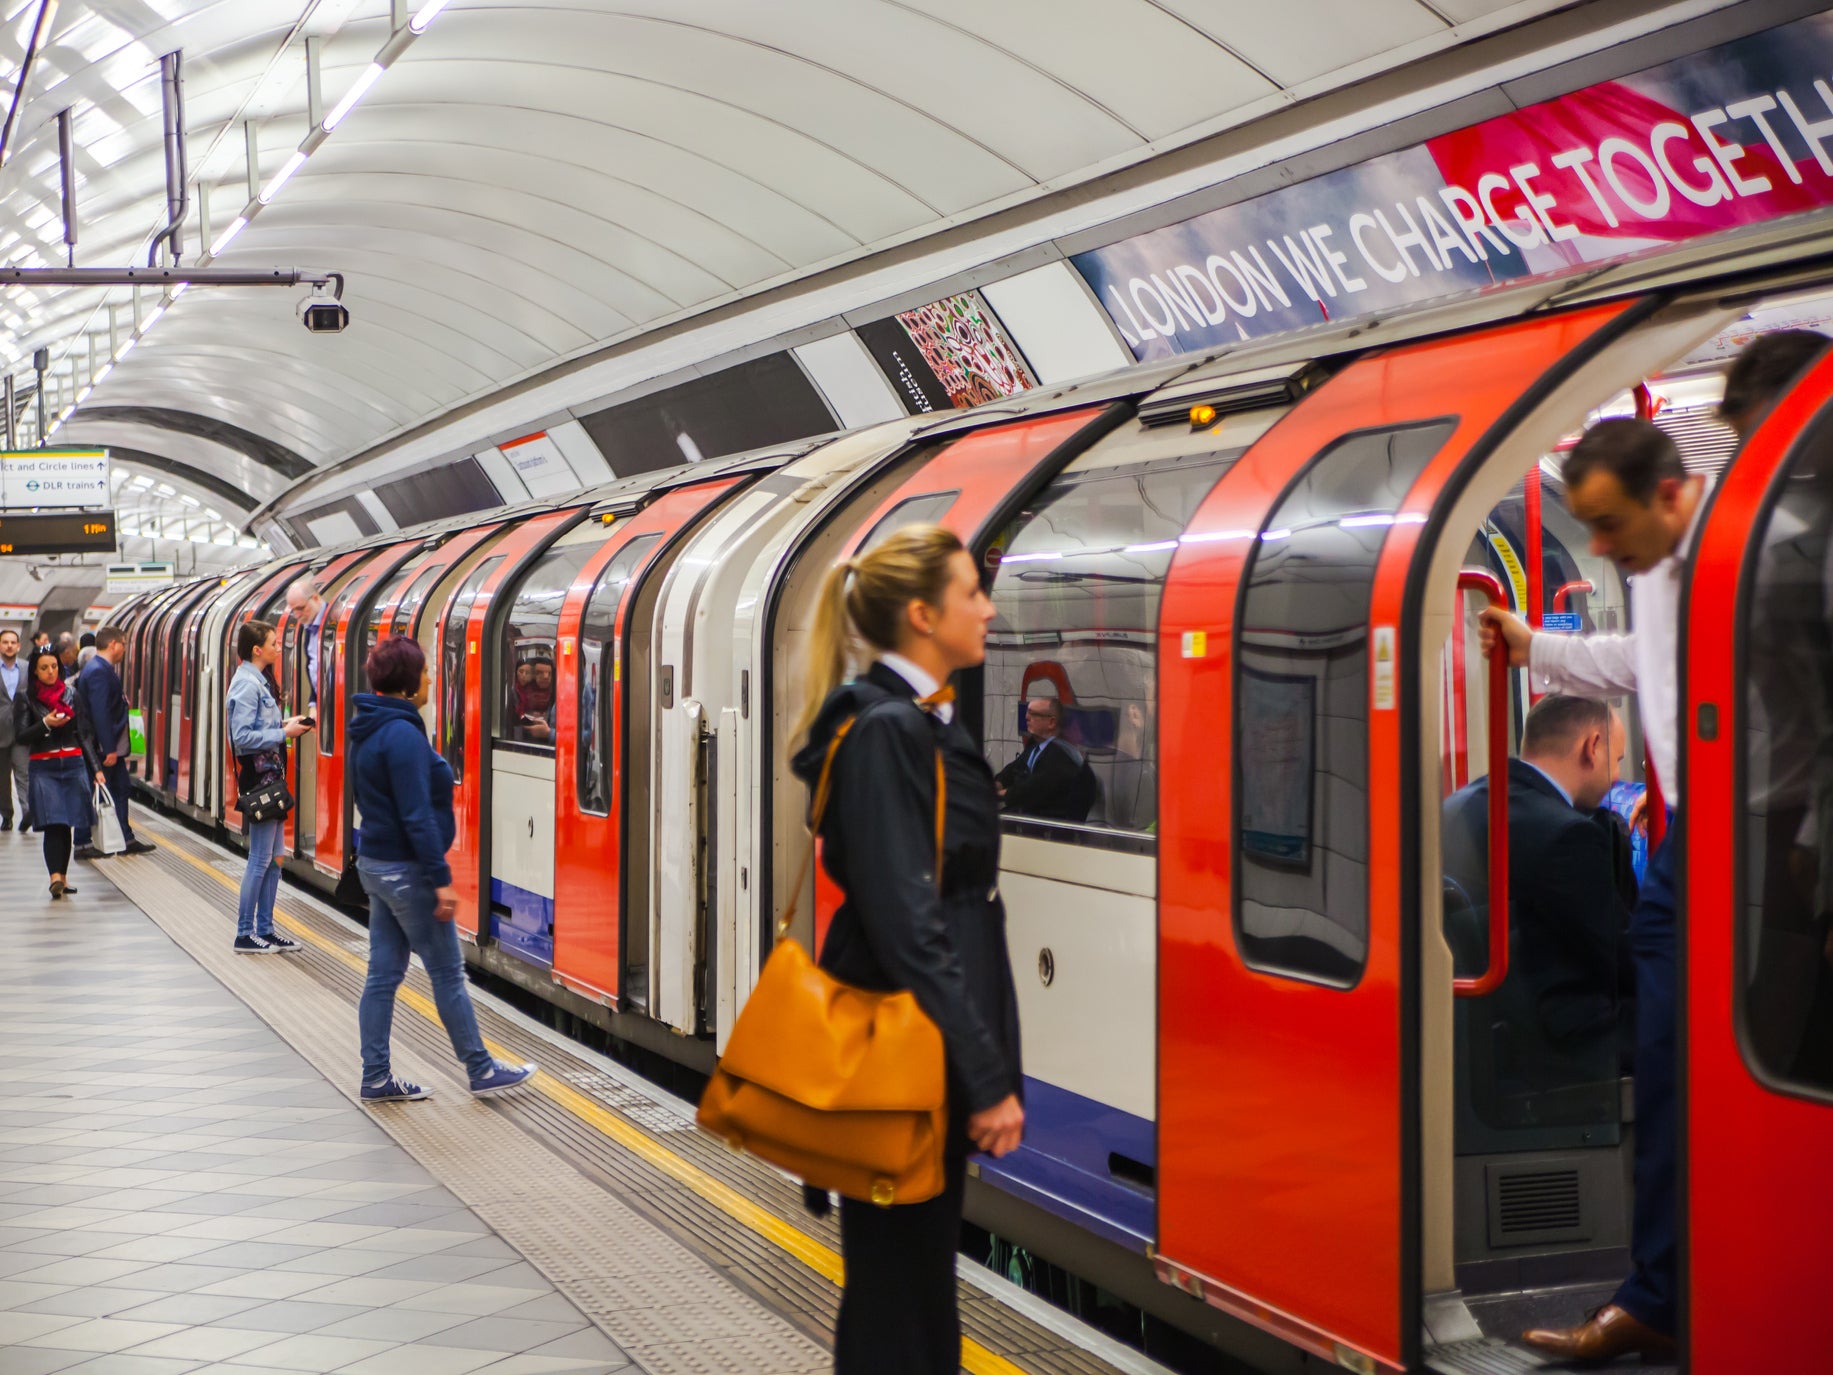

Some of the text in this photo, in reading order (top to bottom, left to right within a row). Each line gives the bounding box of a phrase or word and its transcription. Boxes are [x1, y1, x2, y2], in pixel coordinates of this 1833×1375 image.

[1109, 79, 1833, 341] LONDON WE CHARGE TOGETH
[18, 463, 35, 471] and
[39, 462, 68, 471] Circle
[71, 462, 95, 470] lines
[43, 481, 95, 490] DLR trains
